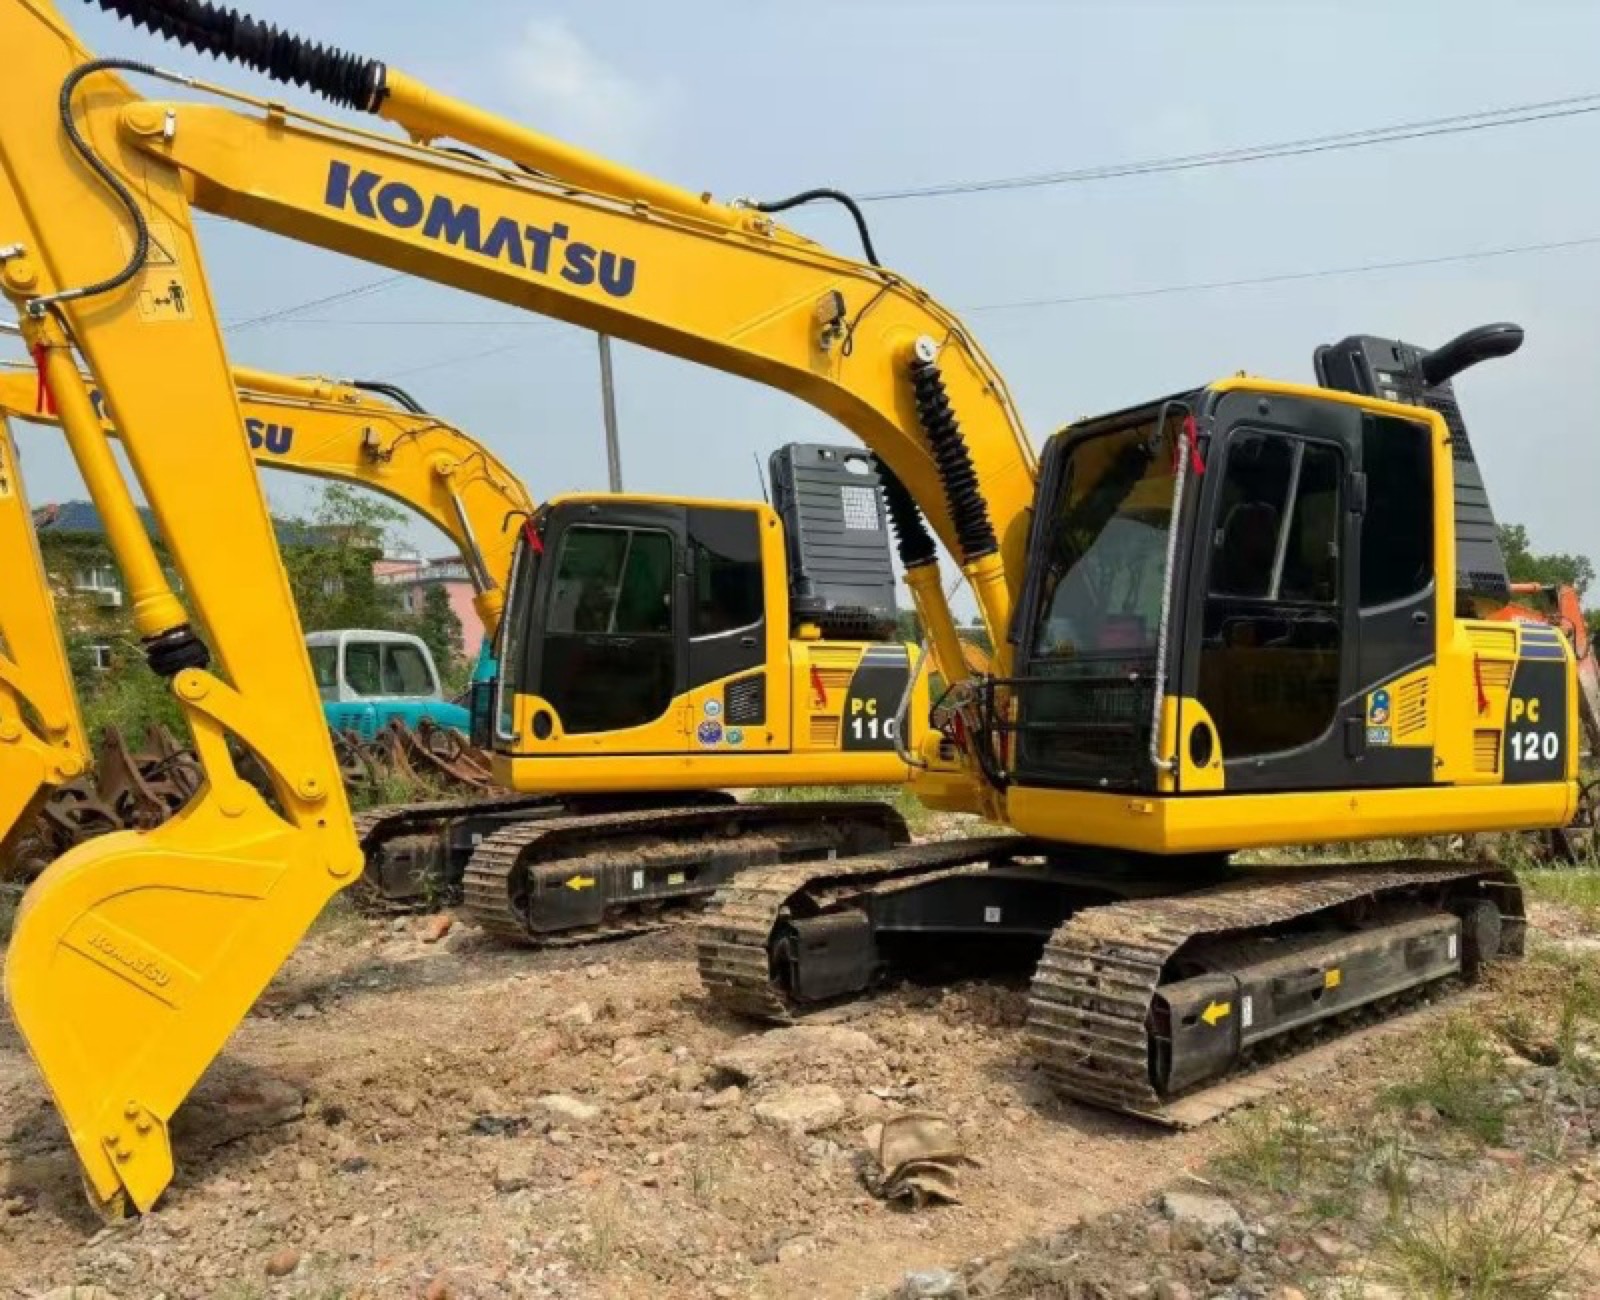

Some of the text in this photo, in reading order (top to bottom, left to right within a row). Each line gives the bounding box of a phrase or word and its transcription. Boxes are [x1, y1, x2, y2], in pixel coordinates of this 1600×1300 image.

[324, 159, 636, 298] KOMATSU
[851, 697, 877, 716] PC
[1511, 697, 1541, 723] PC
[1510, 731, 1559, 761] 120
